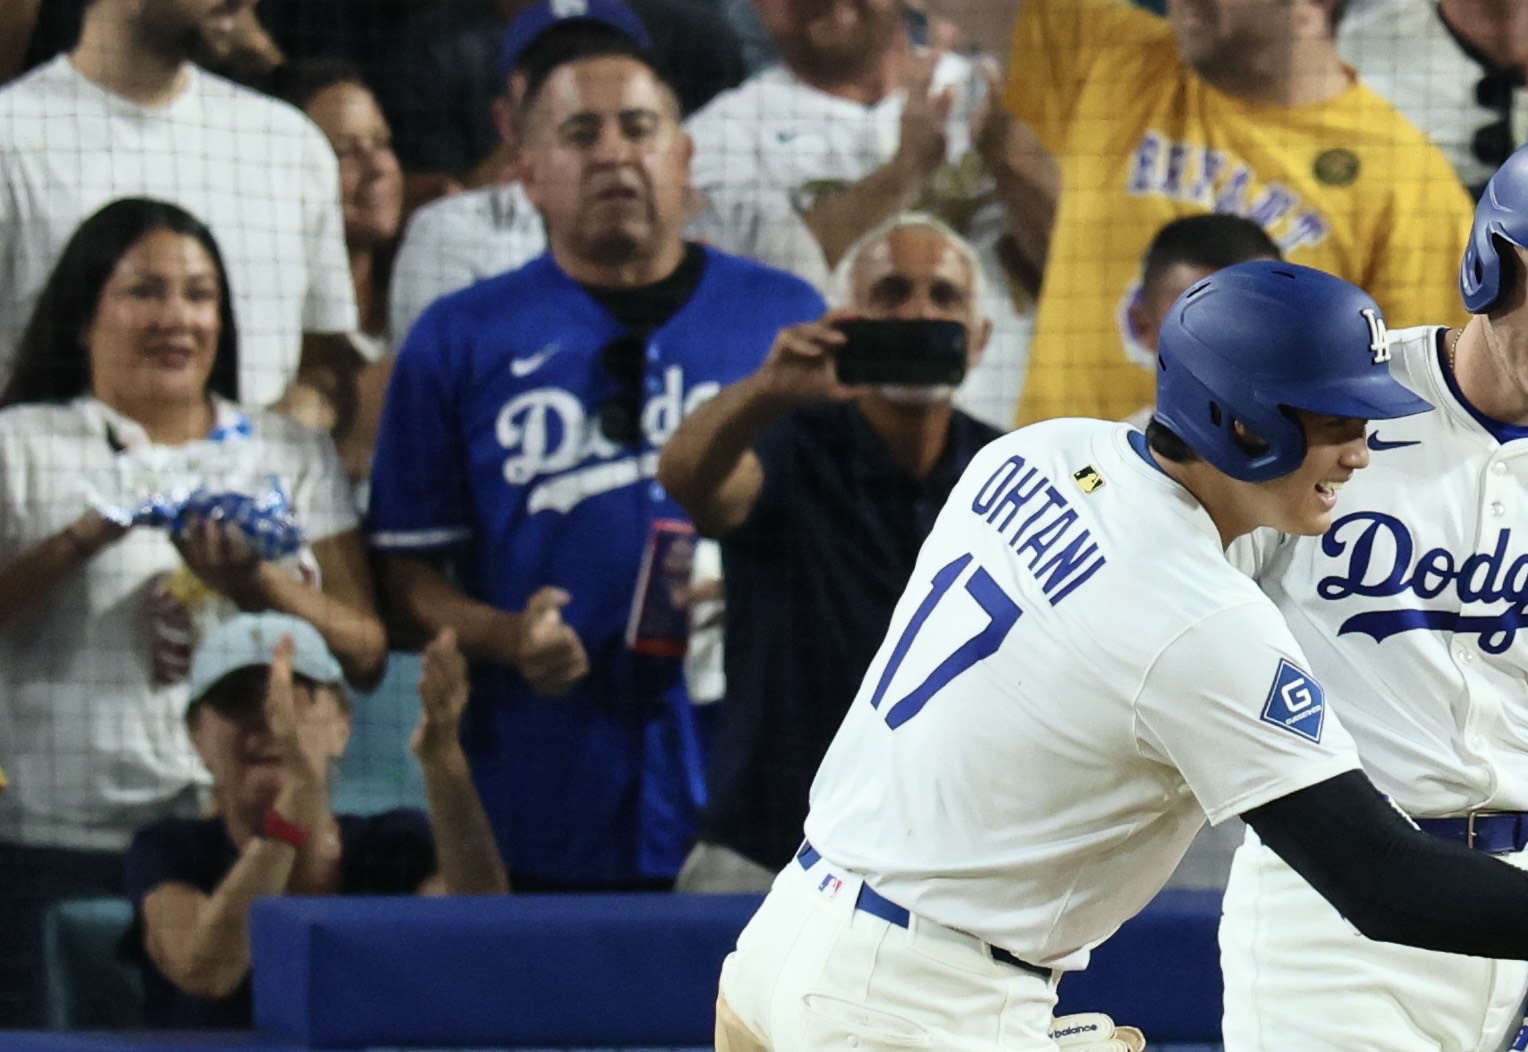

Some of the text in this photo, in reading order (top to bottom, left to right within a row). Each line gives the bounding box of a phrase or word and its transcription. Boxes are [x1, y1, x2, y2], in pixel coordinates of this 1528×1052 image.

[1362, 308, 1392, 364] LA
[971, 454, 1107, 607] OHTANI
[870, 553, 1024, 731] 17
